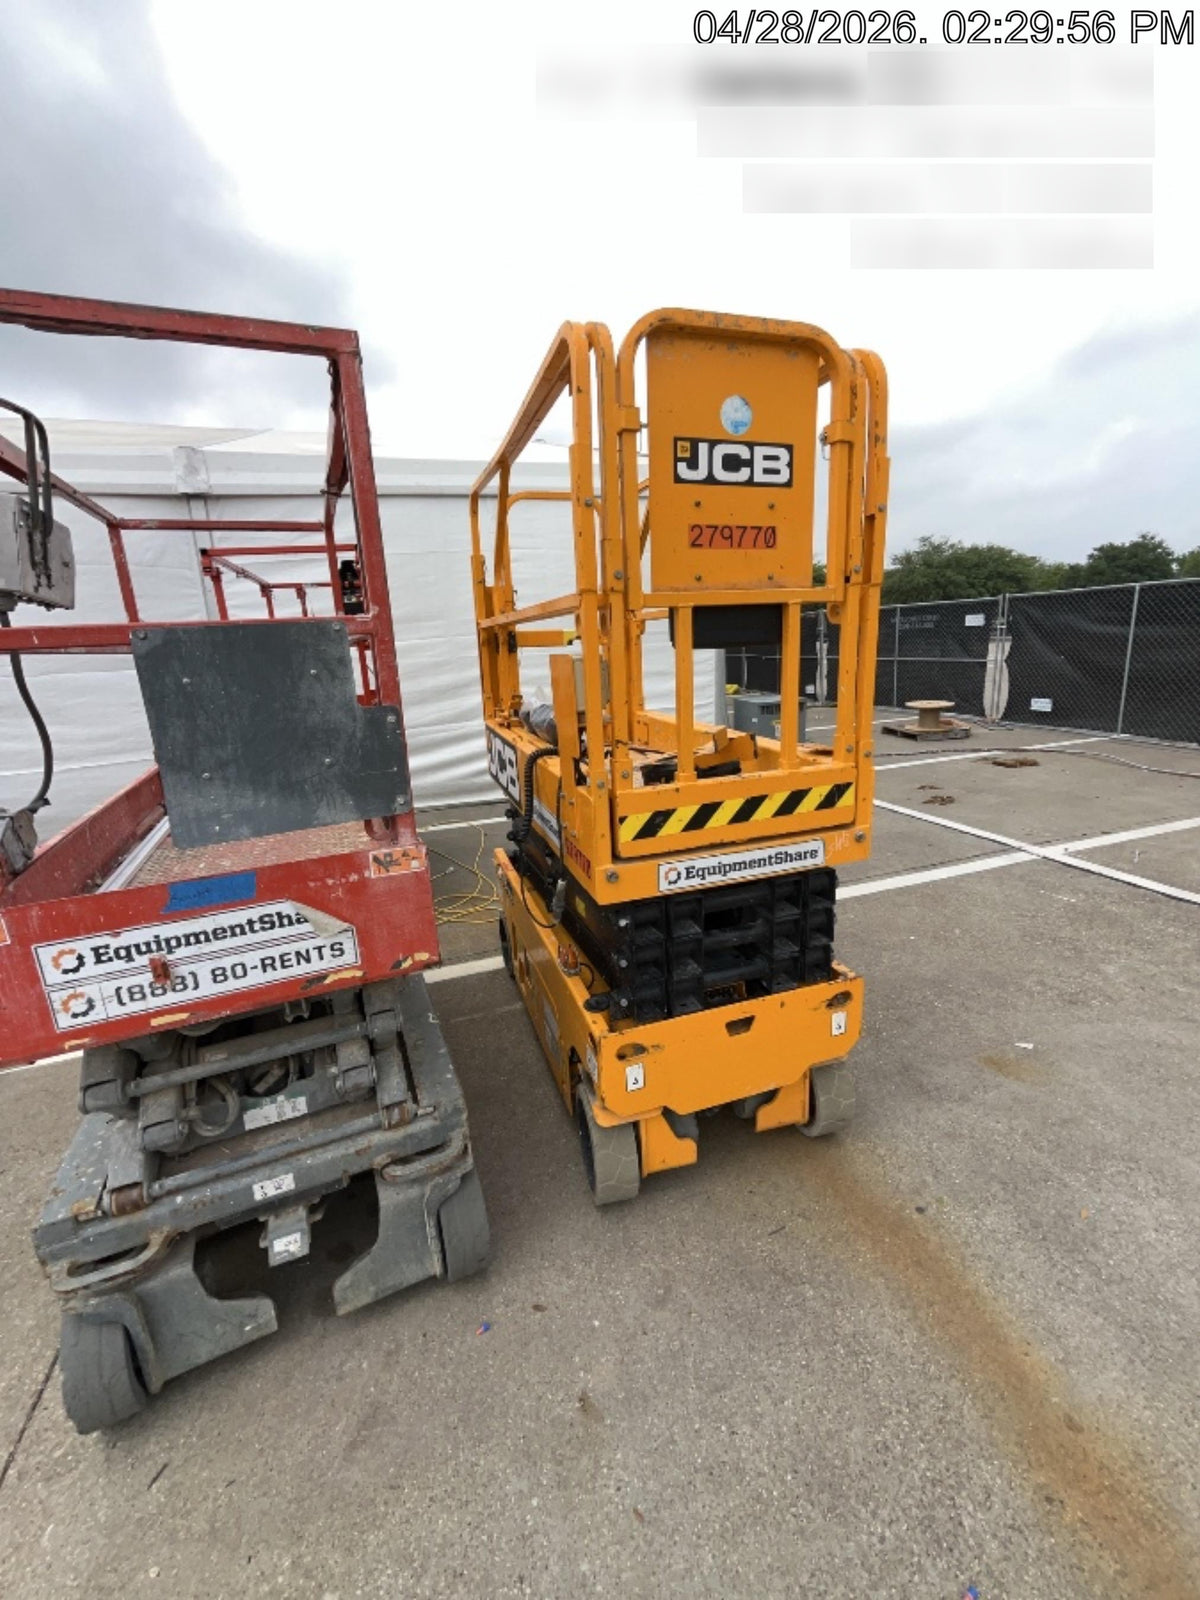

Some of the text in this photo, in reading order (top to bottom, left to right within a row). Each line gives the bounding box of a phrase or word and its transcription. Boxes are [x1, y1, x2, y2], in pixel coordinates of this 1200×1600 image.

[676, 440, 791, 485] JCB
[690, 524, 777, 549] 279770
[488, 733, 520, 802] JCB
[684, 846, 819, 882] EquipmentShare
[90, 910, 310, 966] EquipmentSha
[211, 941, 346, 985] 80-RENTS
